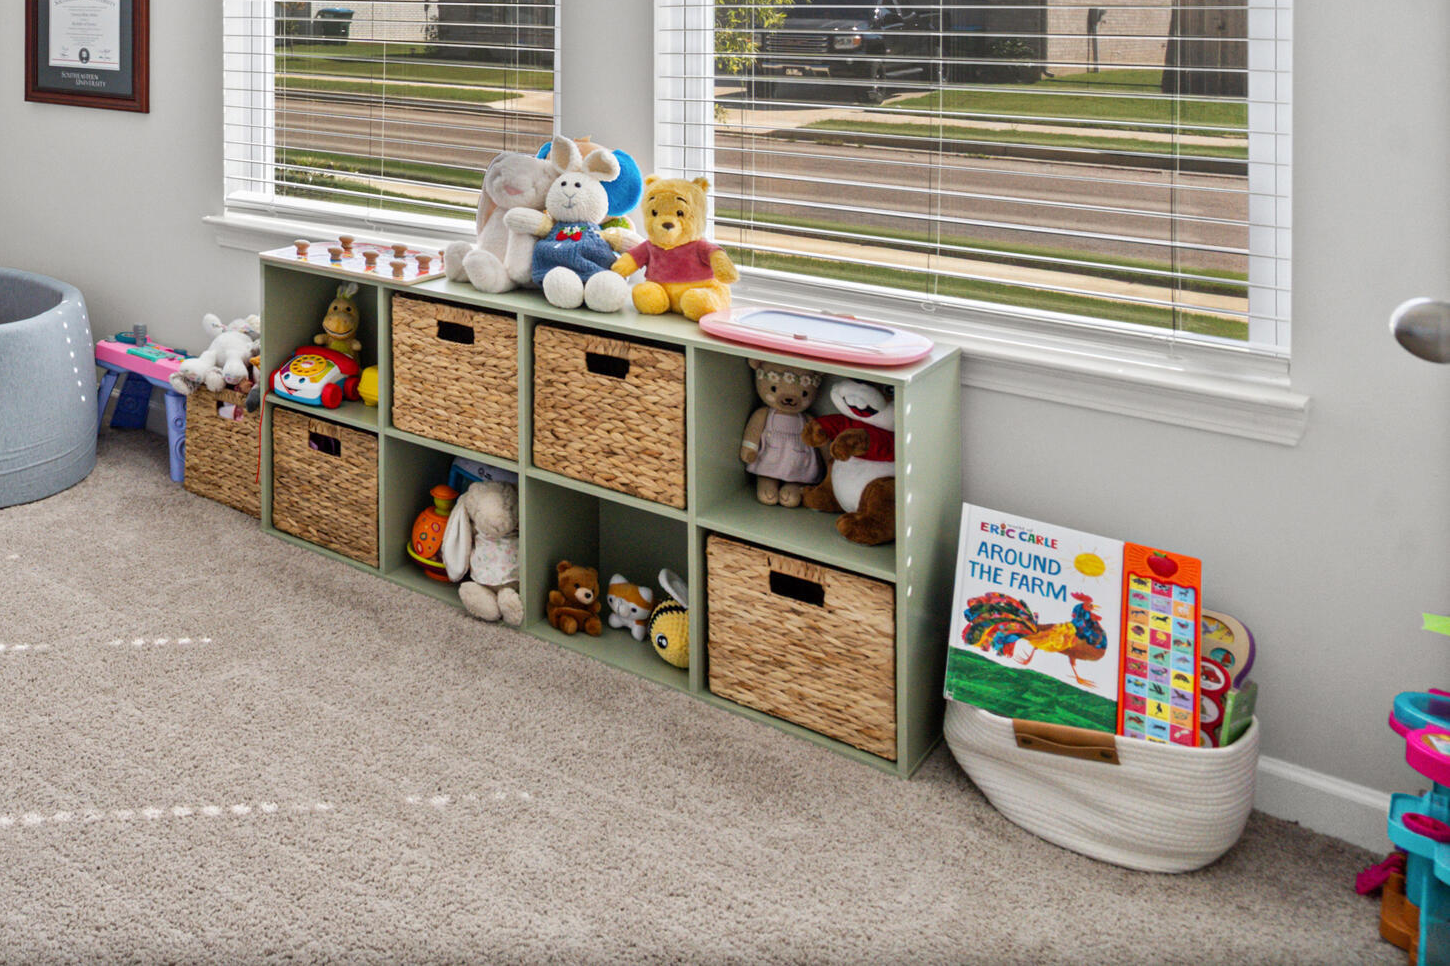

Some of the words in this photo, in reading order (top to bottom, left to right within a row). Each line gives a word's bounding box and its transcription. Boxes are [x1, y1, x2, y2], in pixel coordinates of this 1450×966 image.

[1018, 531, 1059, 550] CARLE
[977, 541, 1062, 576] AROUND
[968, 560, 1004, 585] THE
[1010, 571, 1068, 603] FARM
